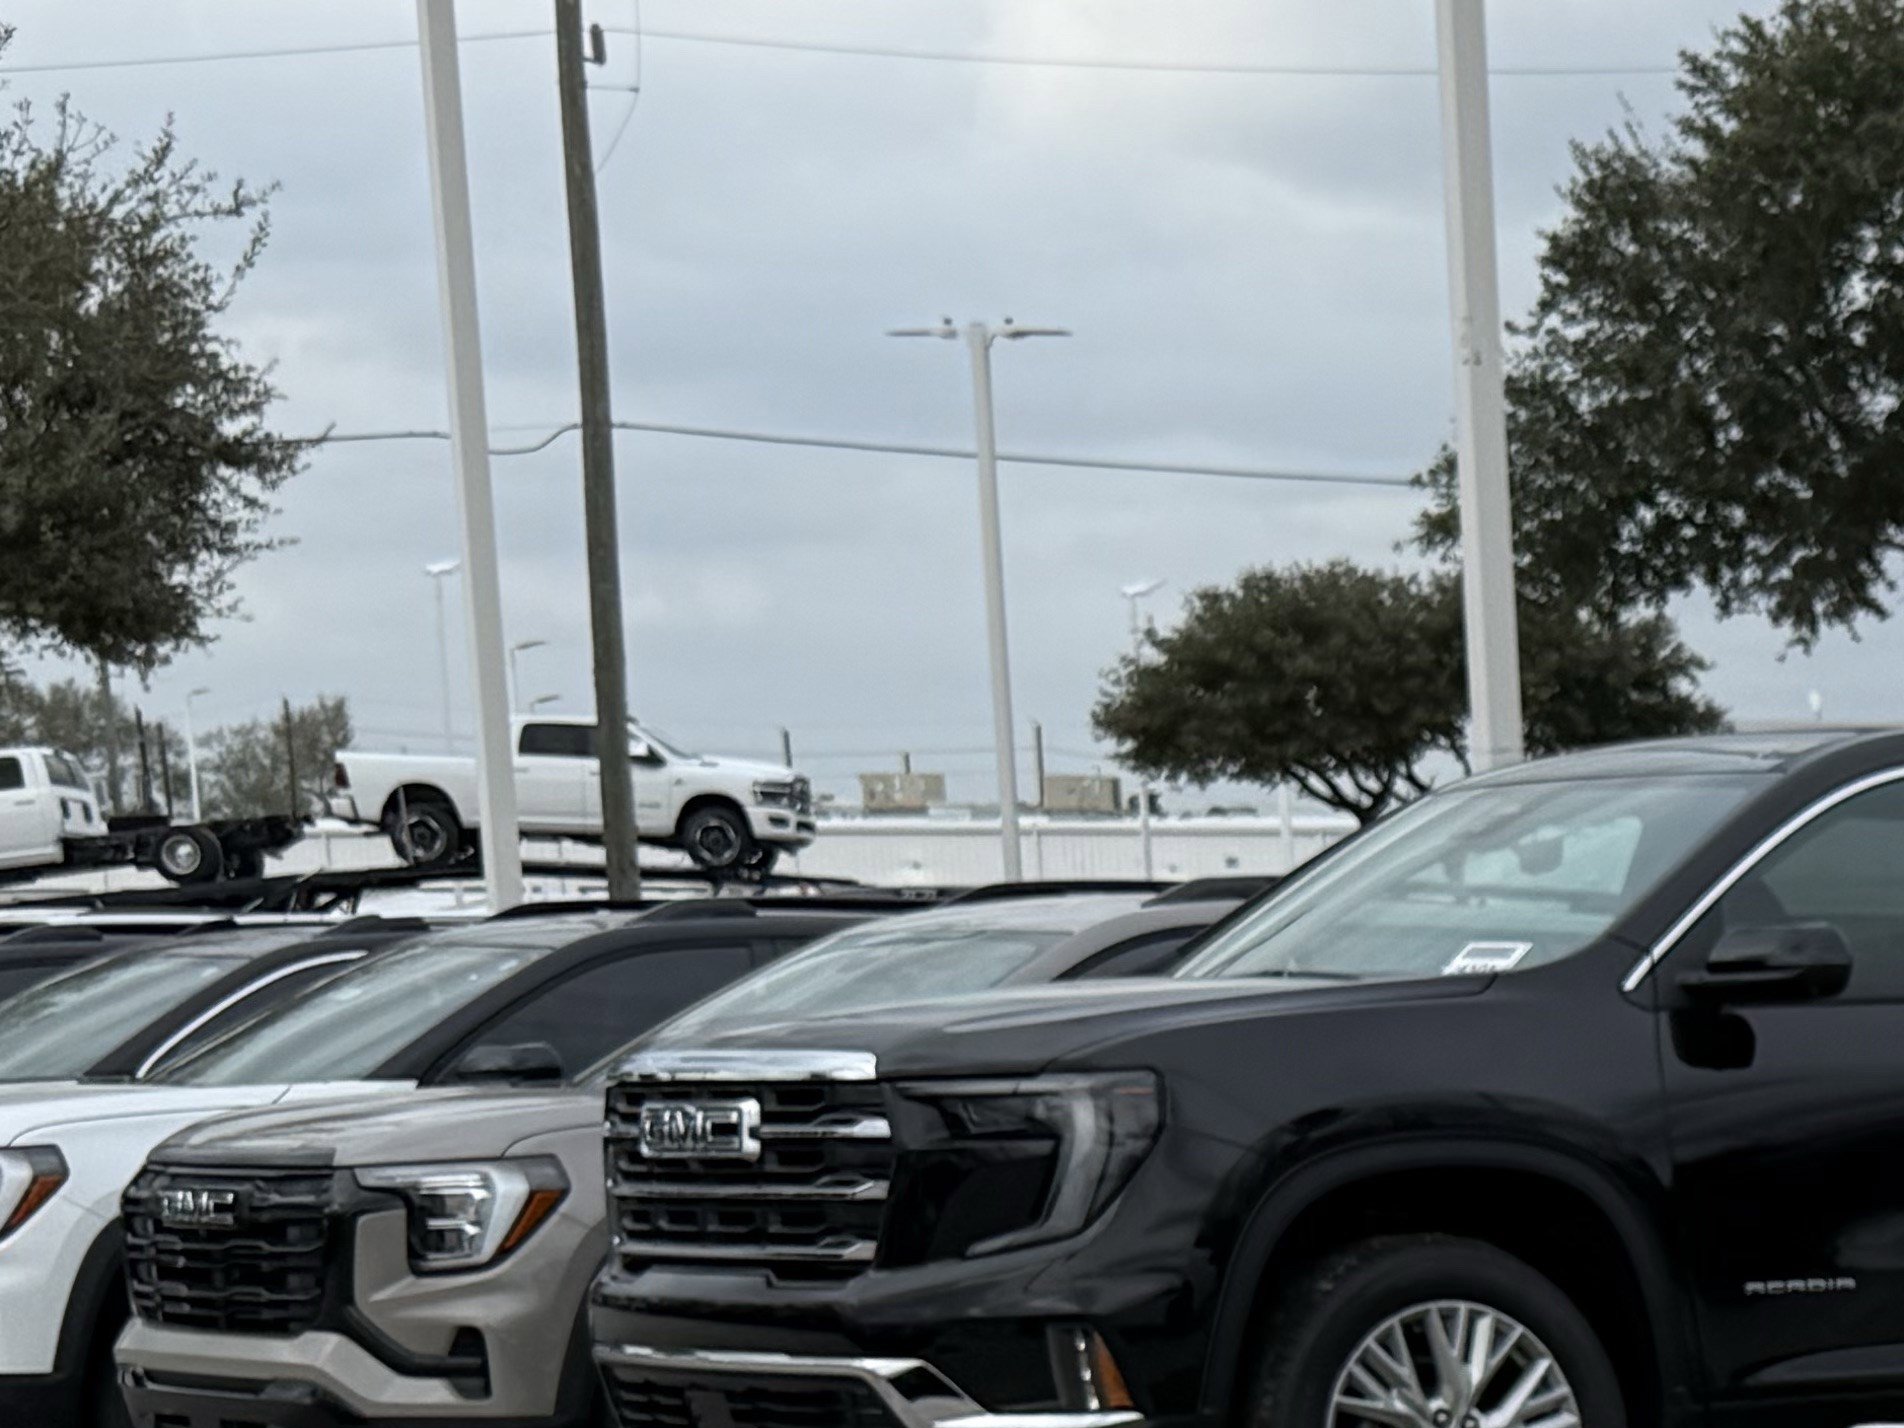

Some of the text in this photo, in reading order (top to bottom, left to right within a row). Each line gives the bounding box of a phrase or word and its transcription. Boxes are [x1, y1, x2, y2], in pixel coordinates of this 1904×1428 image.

[643, 1107, 740, 1152] GMC
[161, 1190, 234, 1226] GMC
[1744, 1277, 1856, 1295] ACADIA
